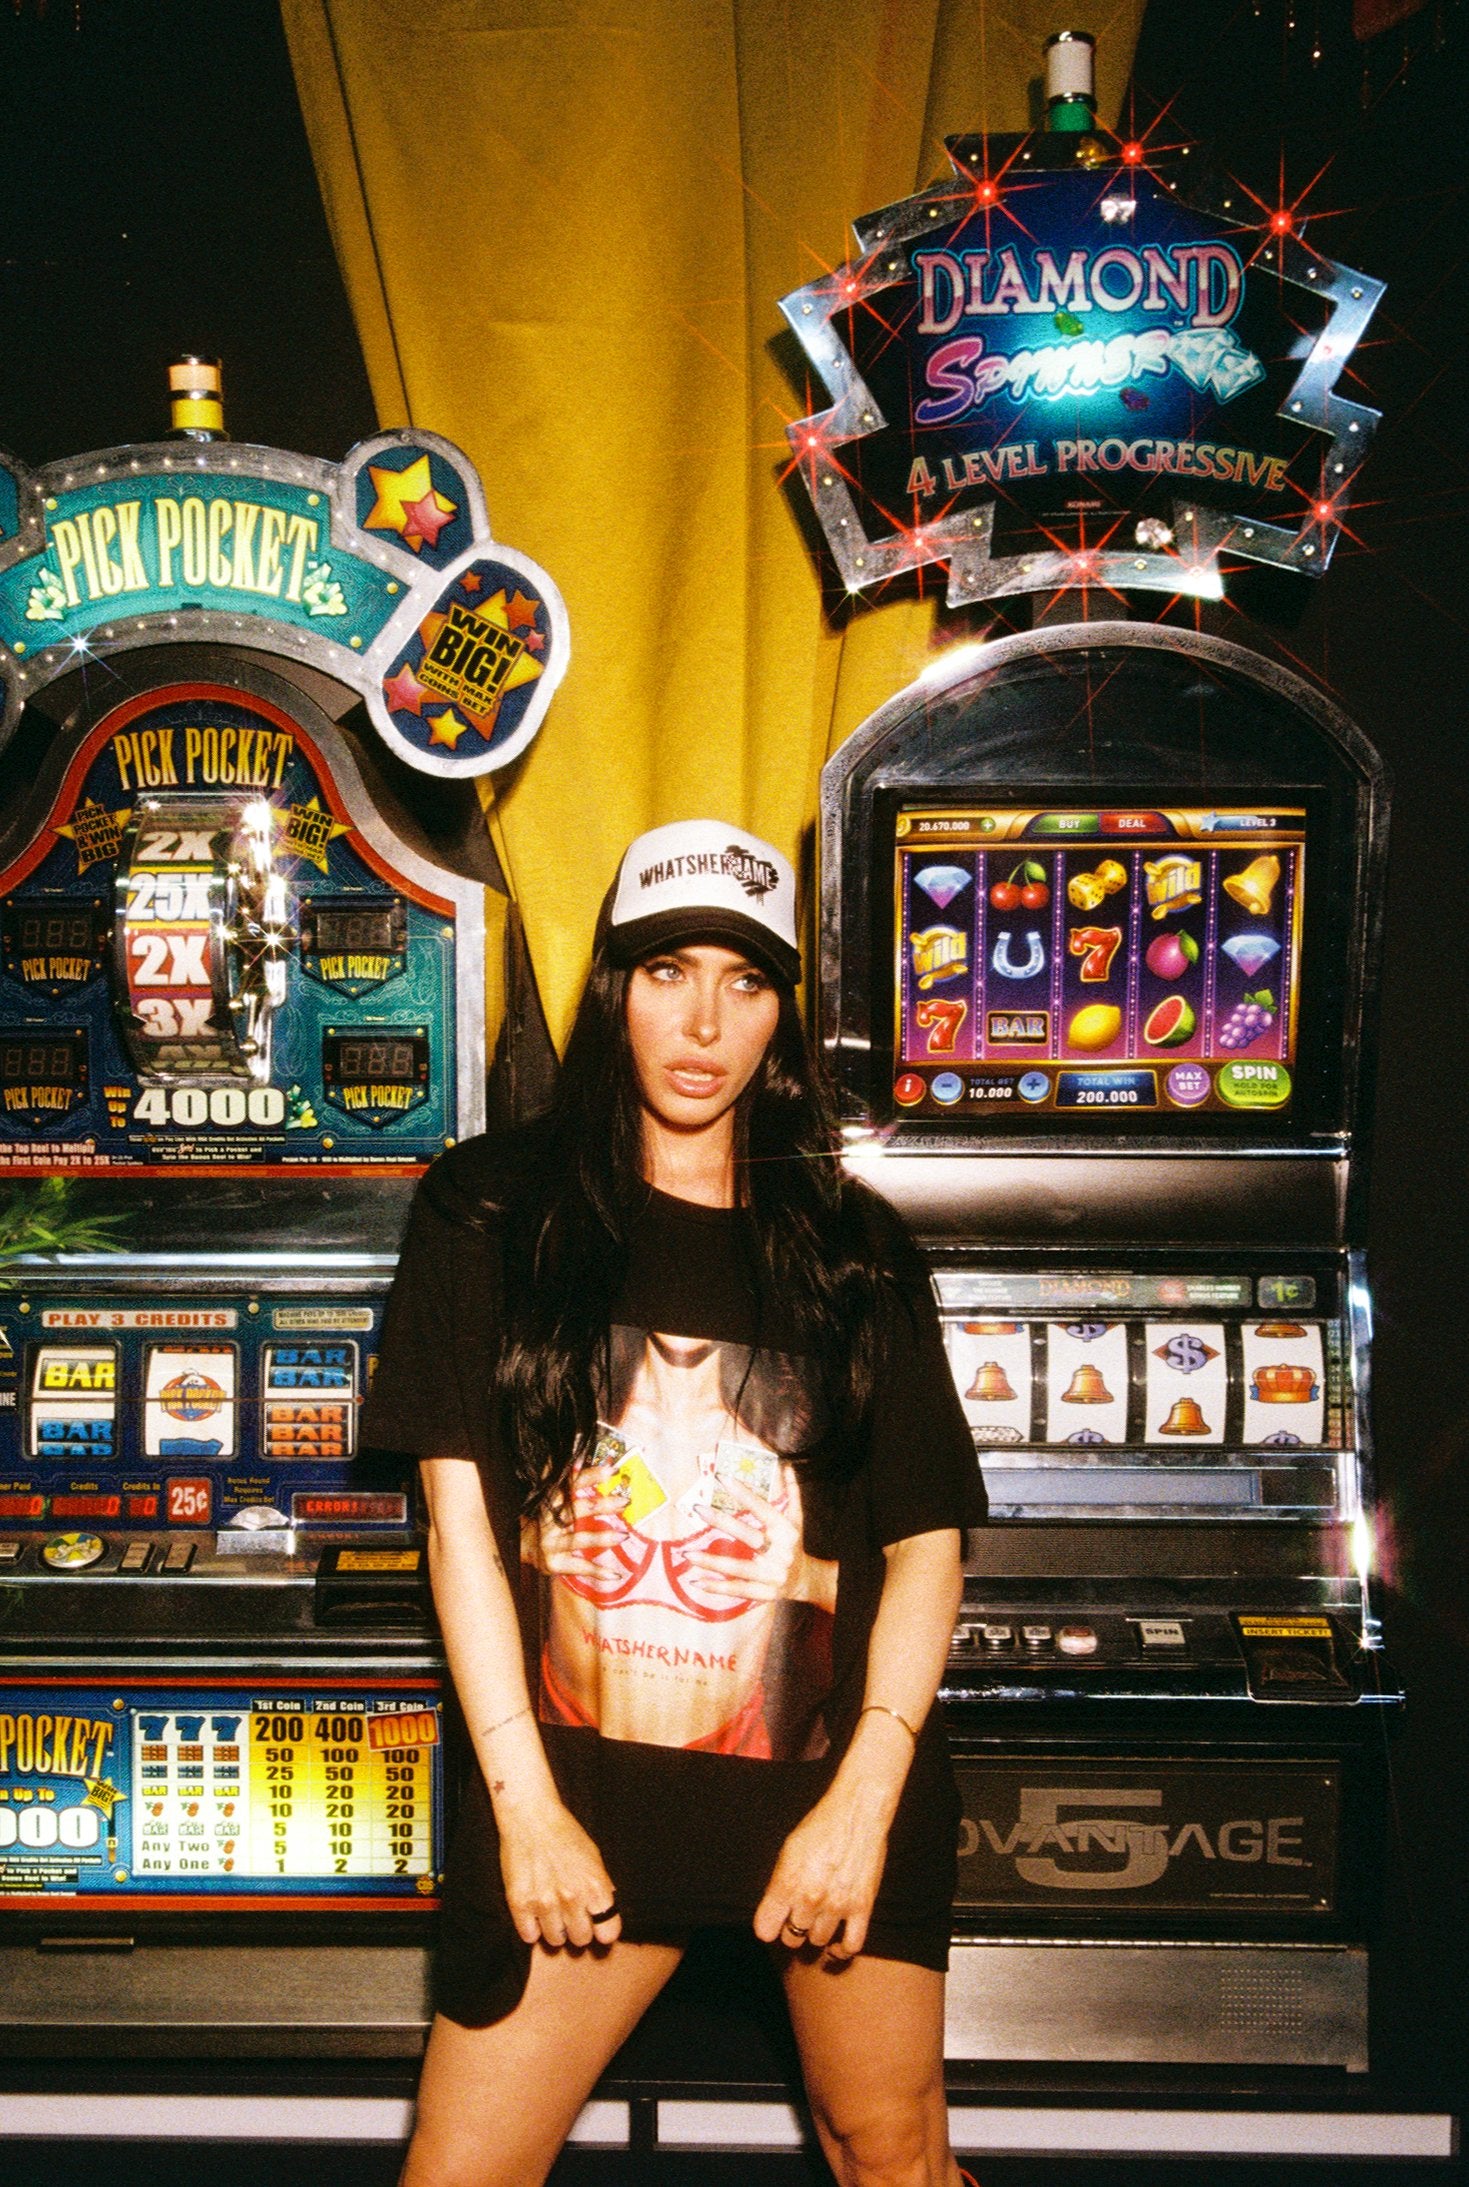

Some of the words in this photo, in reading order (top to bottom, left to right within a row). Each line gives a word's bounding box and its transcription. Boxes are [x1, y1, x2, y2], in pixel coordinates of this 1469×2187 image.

[916, 246, 1240, 334] DIAMOND
[906, 456, 937, 496] 4
[942, 443, 1047, 490] LEVEL
[1056, 439, 1289, 492] PROGRESSIVE
[52, 501, 149, 607] PICK
[155, 497, 317, 602] POCKET
[451, 607, 521, 657] WIN
[429, 625, 511, 694] BIG!
[423, 663, 460, 686] WITH
[463, 685, 493, 704] MAX
[420, 674, 460, 699] COINS
[462, 697, 487, 713] BET
[113, 729, 179, 790] PICK
[185, 727, 293, 789] POCKET
[77, 807, 103, 820] PICK
[293, 806, 332, 827] WIN
[1059, 819, 1081, 829] BUY
[1118, 819, 1146, 828] DEAL
[1240, 818, 1268, 827] LEVEL
[89, 826, 120, 844] WIN
[287, 817, 330, 848] BIG!
[82, 843, 117, 862] BIG
[138, 831, 218, 861] 2X
[127, 872, 213, 921] 25X
[132, 935, 211, 985] 2X
[1069, 927, 1122, 982] 7
[21, 959, 47, 981] PICK
[49, 958, 91, 981] POCKET
[319, 956, 344, 980] PICK
[347, 955, 390, 980] POCKET
[137, 998, 218, 1037] 3X
[916, 999, 967, 1053] 7
[990, 1017, 1044, 1038] BAR
[1175, 1072, 1202, 1081] MAX
[1231, 1066, 1277, 1080] SPIN
[970, 1078, 994, 1086] TOTAL
[1077, 1077, 1110, 1086] TOTAL
[1113, 1076, 1136, 1085] WIN
[1180, 1081, 1201, 1090] BET
[4, 1087, 29, 1111] PICK
[30, 1086, 73, 1110] POCKET
[104, 1086, 131, 1098] Win
[342, 1086, 368, 1110] PICK
[370, 1085, 413, 1110] POCKET
[969, 1088, 1012, 1098] 10.000
[1076, 1091, 1138, 1103] 200.000
[108, 1101, 126, 1113] Up
[133, 1088, 285, 1126] 4000
[110, 1116, 126, 1128] To
[14, 1143, 29, 1154] Top
[51, 1143, 60, 1153] to
[12, 1155, 31, 1165] First
[33, 1155, 51, 1165] Coin
[53, 1155, 68, 1166] Pay
[70, 1155, 80, 1165] 2X
[83, 1155, 92, 1165] to
[94, 1155, 110, 1165] 25X
[49, 1313, 99, 1326] PLAY
[111, 1313, 125, 1326] 3
[135, 1313, 227, 1326] CREDITS
[276, 1350, 347, 1364] BAR
[45, 1362, 115, 1388] BAR
[274, 1369, 345, 1386] BAR
[272, 1407, 343, 1422] BAR
[42, 1421, 112, 1440] BAR
[272, 1425, 343, 1440] BAR
[13, 1482, 31, 1490] Paid
[71, 1482, 99, 1490] Credits
[123, 1482, 150, 1490] Credits
[171, 1487, 208, 1515] 25¢
[1145, 1627, 1178, 1636] SPIN
[257, 1702, 274, 1710] 1st
[276, 1702, 301, 1710] Coin
[315, 1701, 336, 1711] 2nd
[340, 1702, 364, 1711] Coin
[377, 1702, 396, 1711] 3rd
[400, 1702, 424, 1710] Coin
[256, 1717, 303, 1742] 200
[315, 1717, 363, 1742] 400
[368, 1714, 436, 1747] 1000
[0, 1714, 113, 1779] POCKET
[266, 1748, 294, 1762] 50
[321, 1749, 358, 1763] 100
[382, 1749, 419, 1763] 100
[266, 1767, 294, 1780] 25
[325, 1767, 353, 1781] 50
[385, 1767, 414, 1781] 50
[13, 1788, 33, 1801] Up
[37, 1788, 55, 1800] To
[142, 1786, 168, 1796] BAR
[178, 1786, 204, 1796] BAR
[214, 1786, 240, 1796] BAR
[269, 1785, 292, 1799] 10
[326, 1786, 353, 1799] 20
[386, 1786, 414, 1800] 20
[269, 1804, 292, 1817] 10
[326, 1804, 353, 1818] 20
[386, 1804, 414, 1818] 20
[274, 1823, 286, 1836] 5
[328, 1823, 352, 1836] 10
[388, 1823, 413, 1837] 10
[1015, 1788, 1168, 1889] 5
[142, 1841, 170, 1852] Any
[179, 1841, 210, 1851] Two
[275, 1842, 287, 1854] 5
[328, 1842, 352, 1855] 10
[388, 1842, 413, 1856] 10
[143, 1859, 171, 1870] Any
[179, 1858, 210, 1869] One
[276, 1860, 285, 1873] 1
[335, 1860, 347, 1873] 2
[395, 1860, 408, 1873] 2
